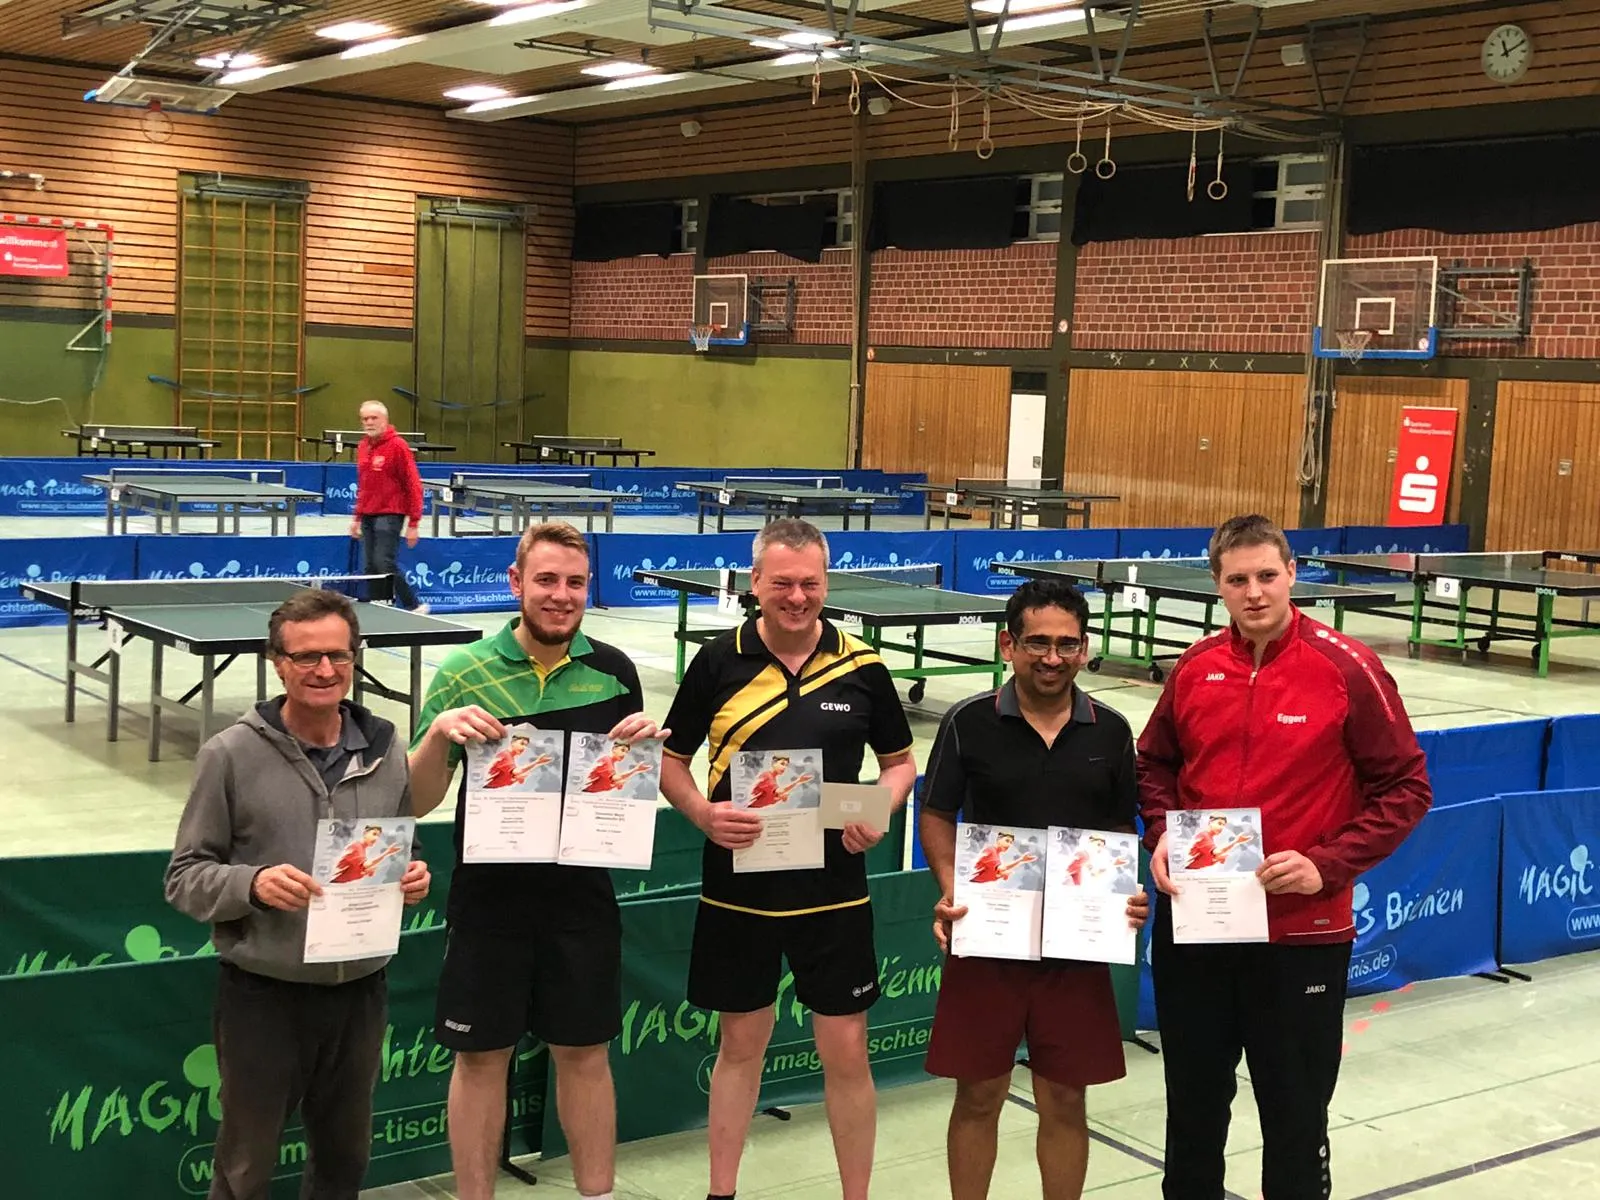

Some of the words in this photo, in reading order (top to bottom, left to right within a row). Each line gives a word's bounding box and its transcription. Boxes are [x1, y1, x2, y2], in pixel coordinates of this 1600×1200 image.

[1443, 582, 1451, 594] 9
[726, 597, 732, 608] 7
[1131, 593, 1138, 604] 8
[843, 613, 863, 625] JOOLA
[958, 615, 983, 625] JOOLA
[1205, 672, 1225, 682] JAKO
[820, 702, 851, 712] GEWO
[1277, 712, 1307, 725] Eggert
[1305, 984, 1326, 994] JAKO
